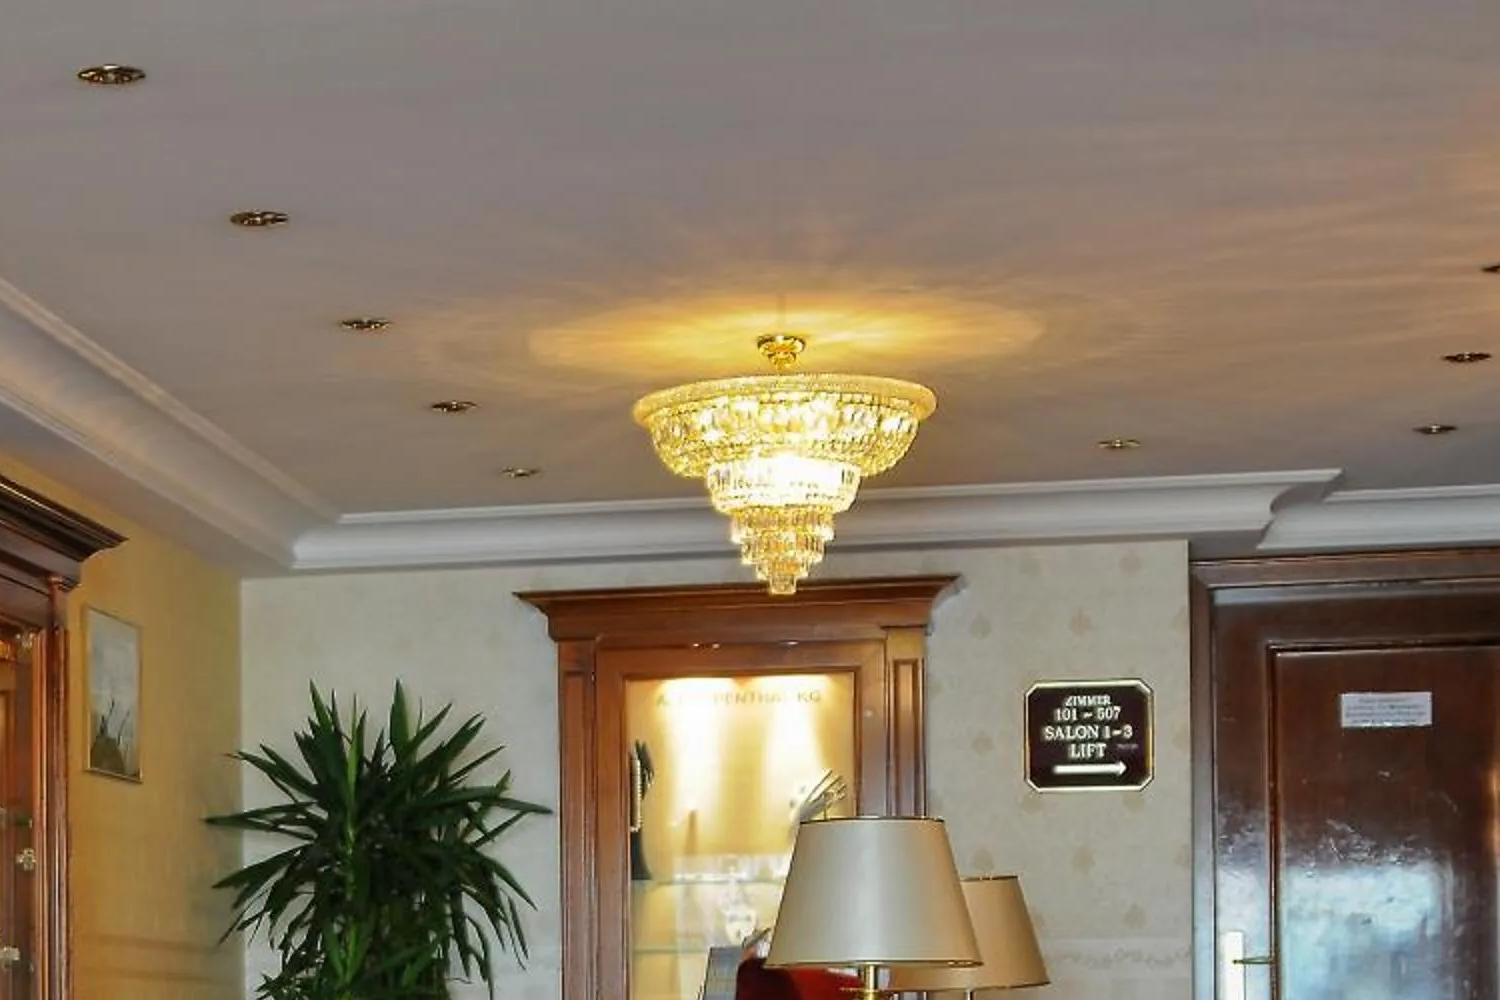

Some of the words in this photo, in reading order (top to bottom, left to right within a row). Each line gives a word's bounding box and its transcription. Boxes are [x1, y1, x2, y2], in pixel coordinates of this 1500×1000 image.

[1065, 695, 1111, 706] ZIMMER
[1055, 707, 1078, 721] 101
[1097, 706, 1121, 720] 507
[1044, 725, 1099, 740] SALON
[1069, 743, 1107, 758] LIFT
